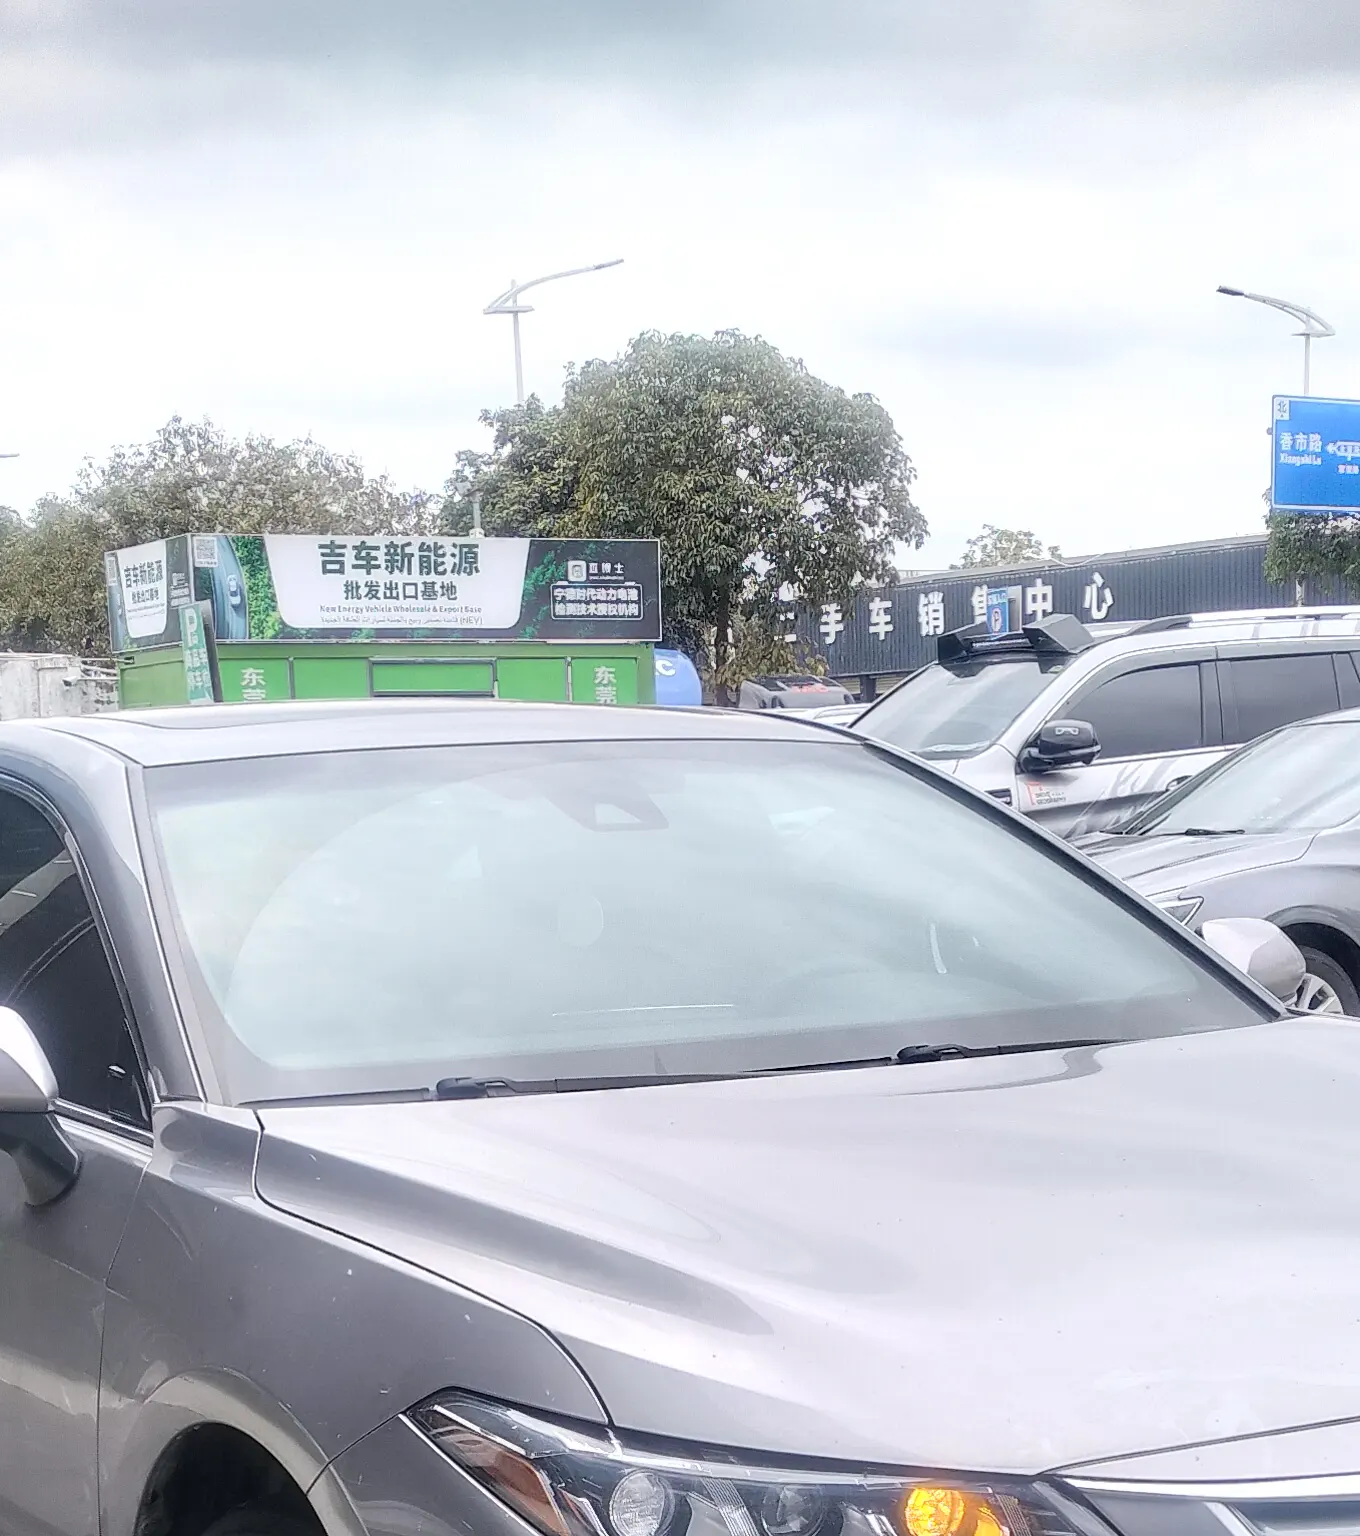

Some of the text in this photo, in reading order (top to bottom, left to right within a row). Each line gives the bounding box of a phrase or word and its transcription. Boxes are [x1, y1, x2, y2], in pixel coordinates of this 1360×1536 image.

[1280, 432, 1322, 452] 香市路
[318, 540, 481, 576] 吉车新能源
[124, 559, 164, 589] 吉车新能源
[343, 580, 459, 601] 批发出口基地
[338, 605, 364, 614] Energy
[365, 604, 392, 613] Vehicle
[393, 604, 431, 613] Wholesale
